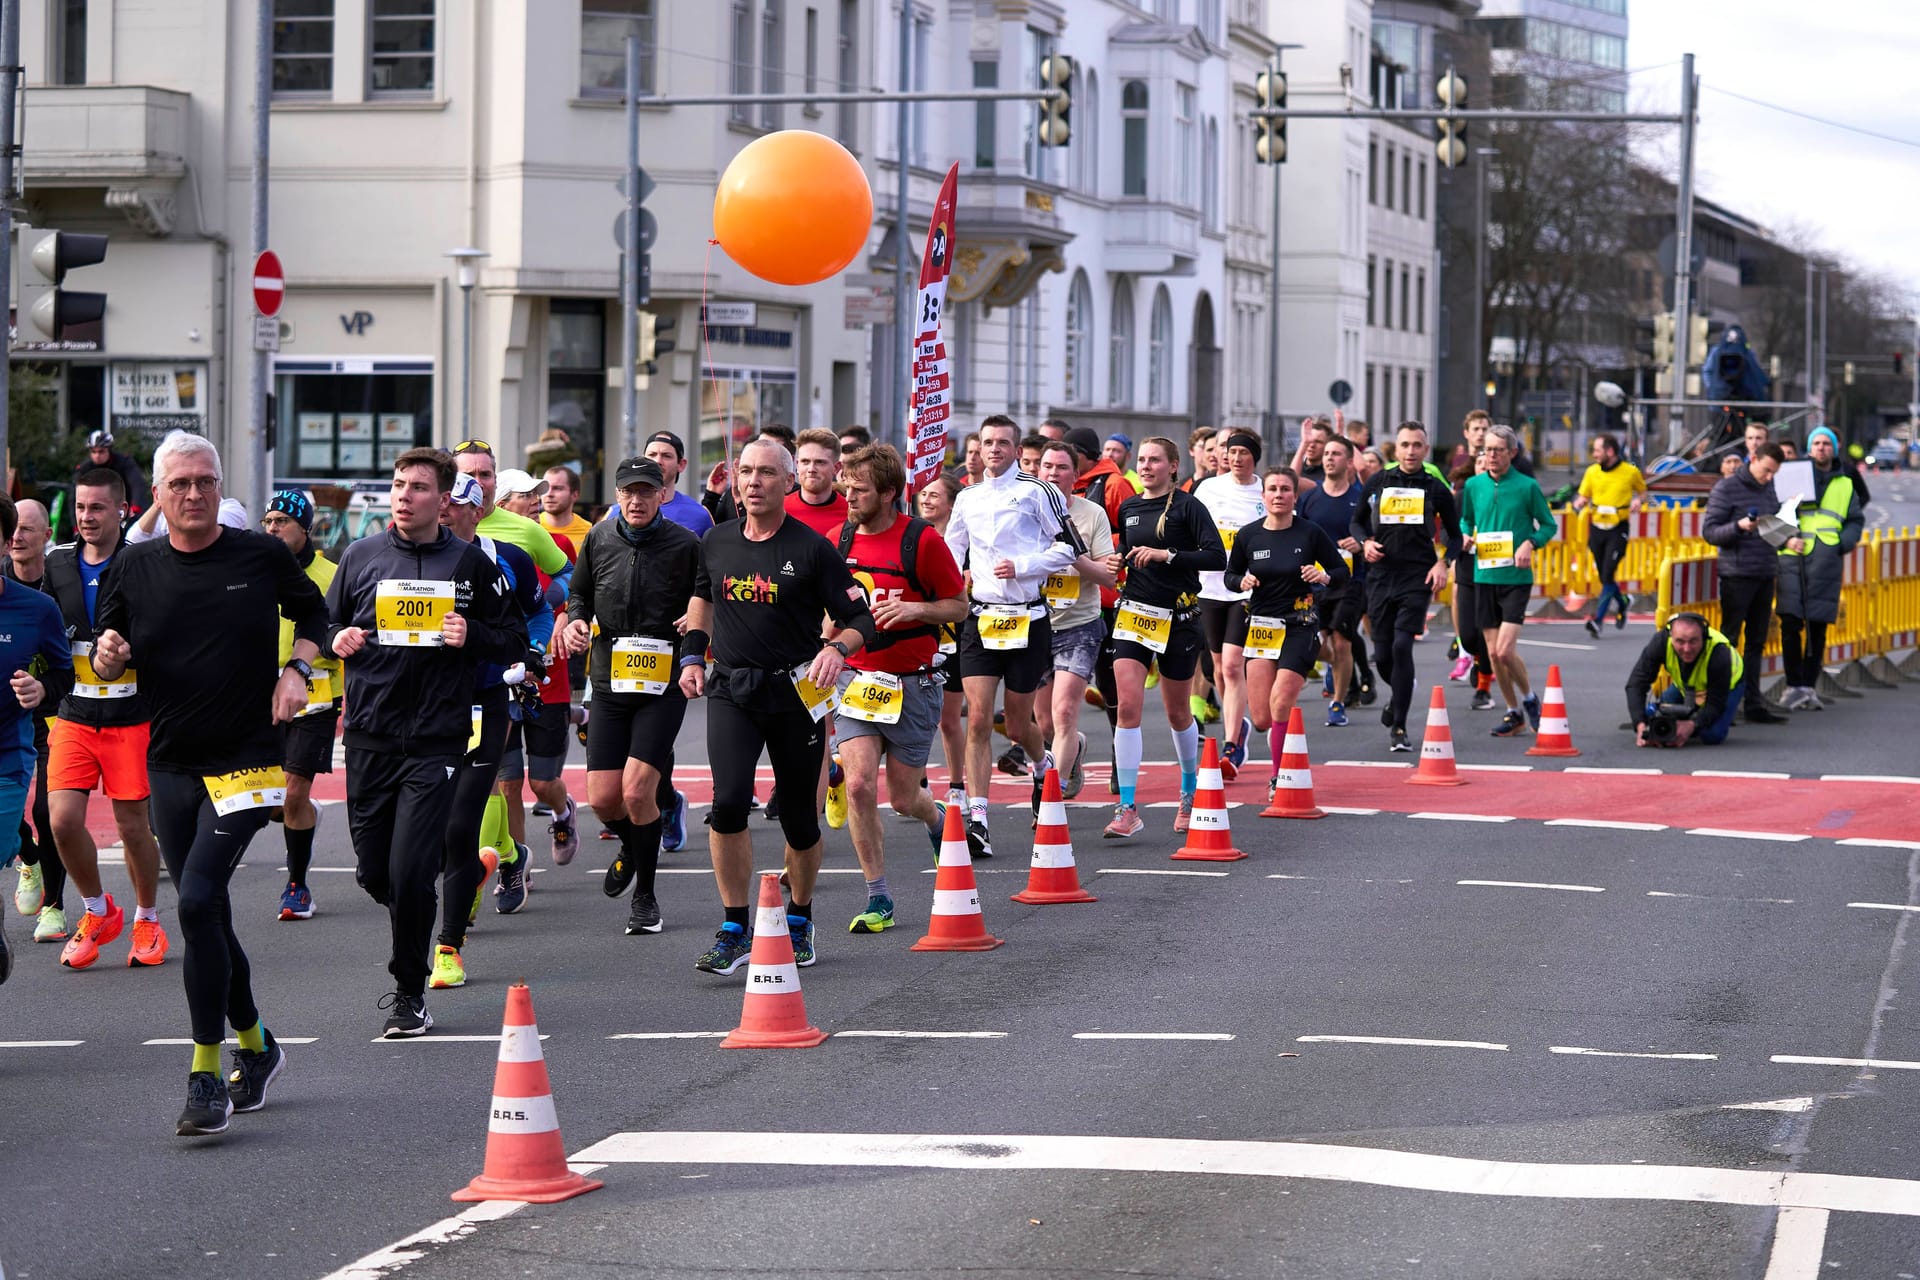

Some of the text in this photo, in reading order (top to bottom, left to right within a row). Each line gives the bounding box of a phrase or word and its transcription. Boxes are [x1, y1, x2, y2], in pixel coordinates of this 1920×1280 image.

[922, 293, 942, 324] 3:
[340, 310, 374, 336] VP
[723, 583, 777, 604] Köln
[396, 600, 433, 617] 2001
[380, 619, 386, 628] C
[992, 619, 1018, 631] 1223
[1133, 615, 1157, 632] 1003
[1250, 628, 1273, 640] 1004
[626, 654, 657, 669] 2008
[613, 669, 619, 678] C
[844, 696, 851, 705] C
[862, 686, 893, 705] 1946
[214, 779, 263, 799] C Klaus
[753, 975, 786, 984] B.A.S.
[493, 1108, 529, 1121] B.A.S.
